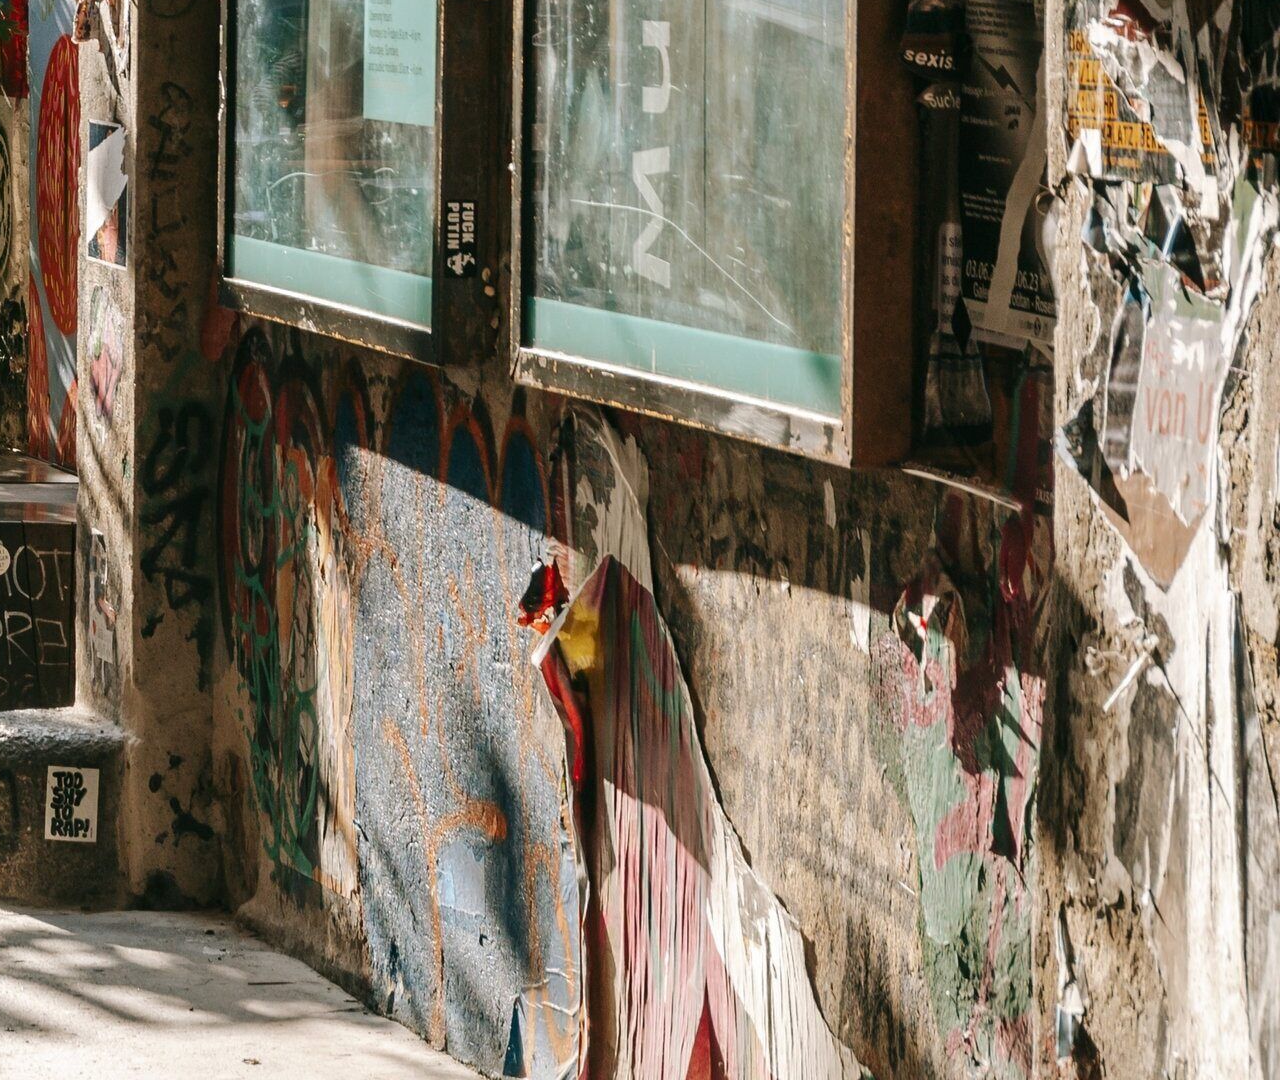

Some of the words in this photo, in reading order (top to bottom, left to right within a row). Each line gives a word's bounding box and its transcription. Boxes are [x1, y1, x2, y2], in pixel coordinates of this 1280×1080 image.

[447, 202, 460, 250] PUTIN
[462, 202, 474, 243] FUCK
[52, 770, 84, 790] TOO
[51, 786, 88, 807] SHY
[50, 803, 75, 821] TO
[50, 816, 90, 839] RAP!
